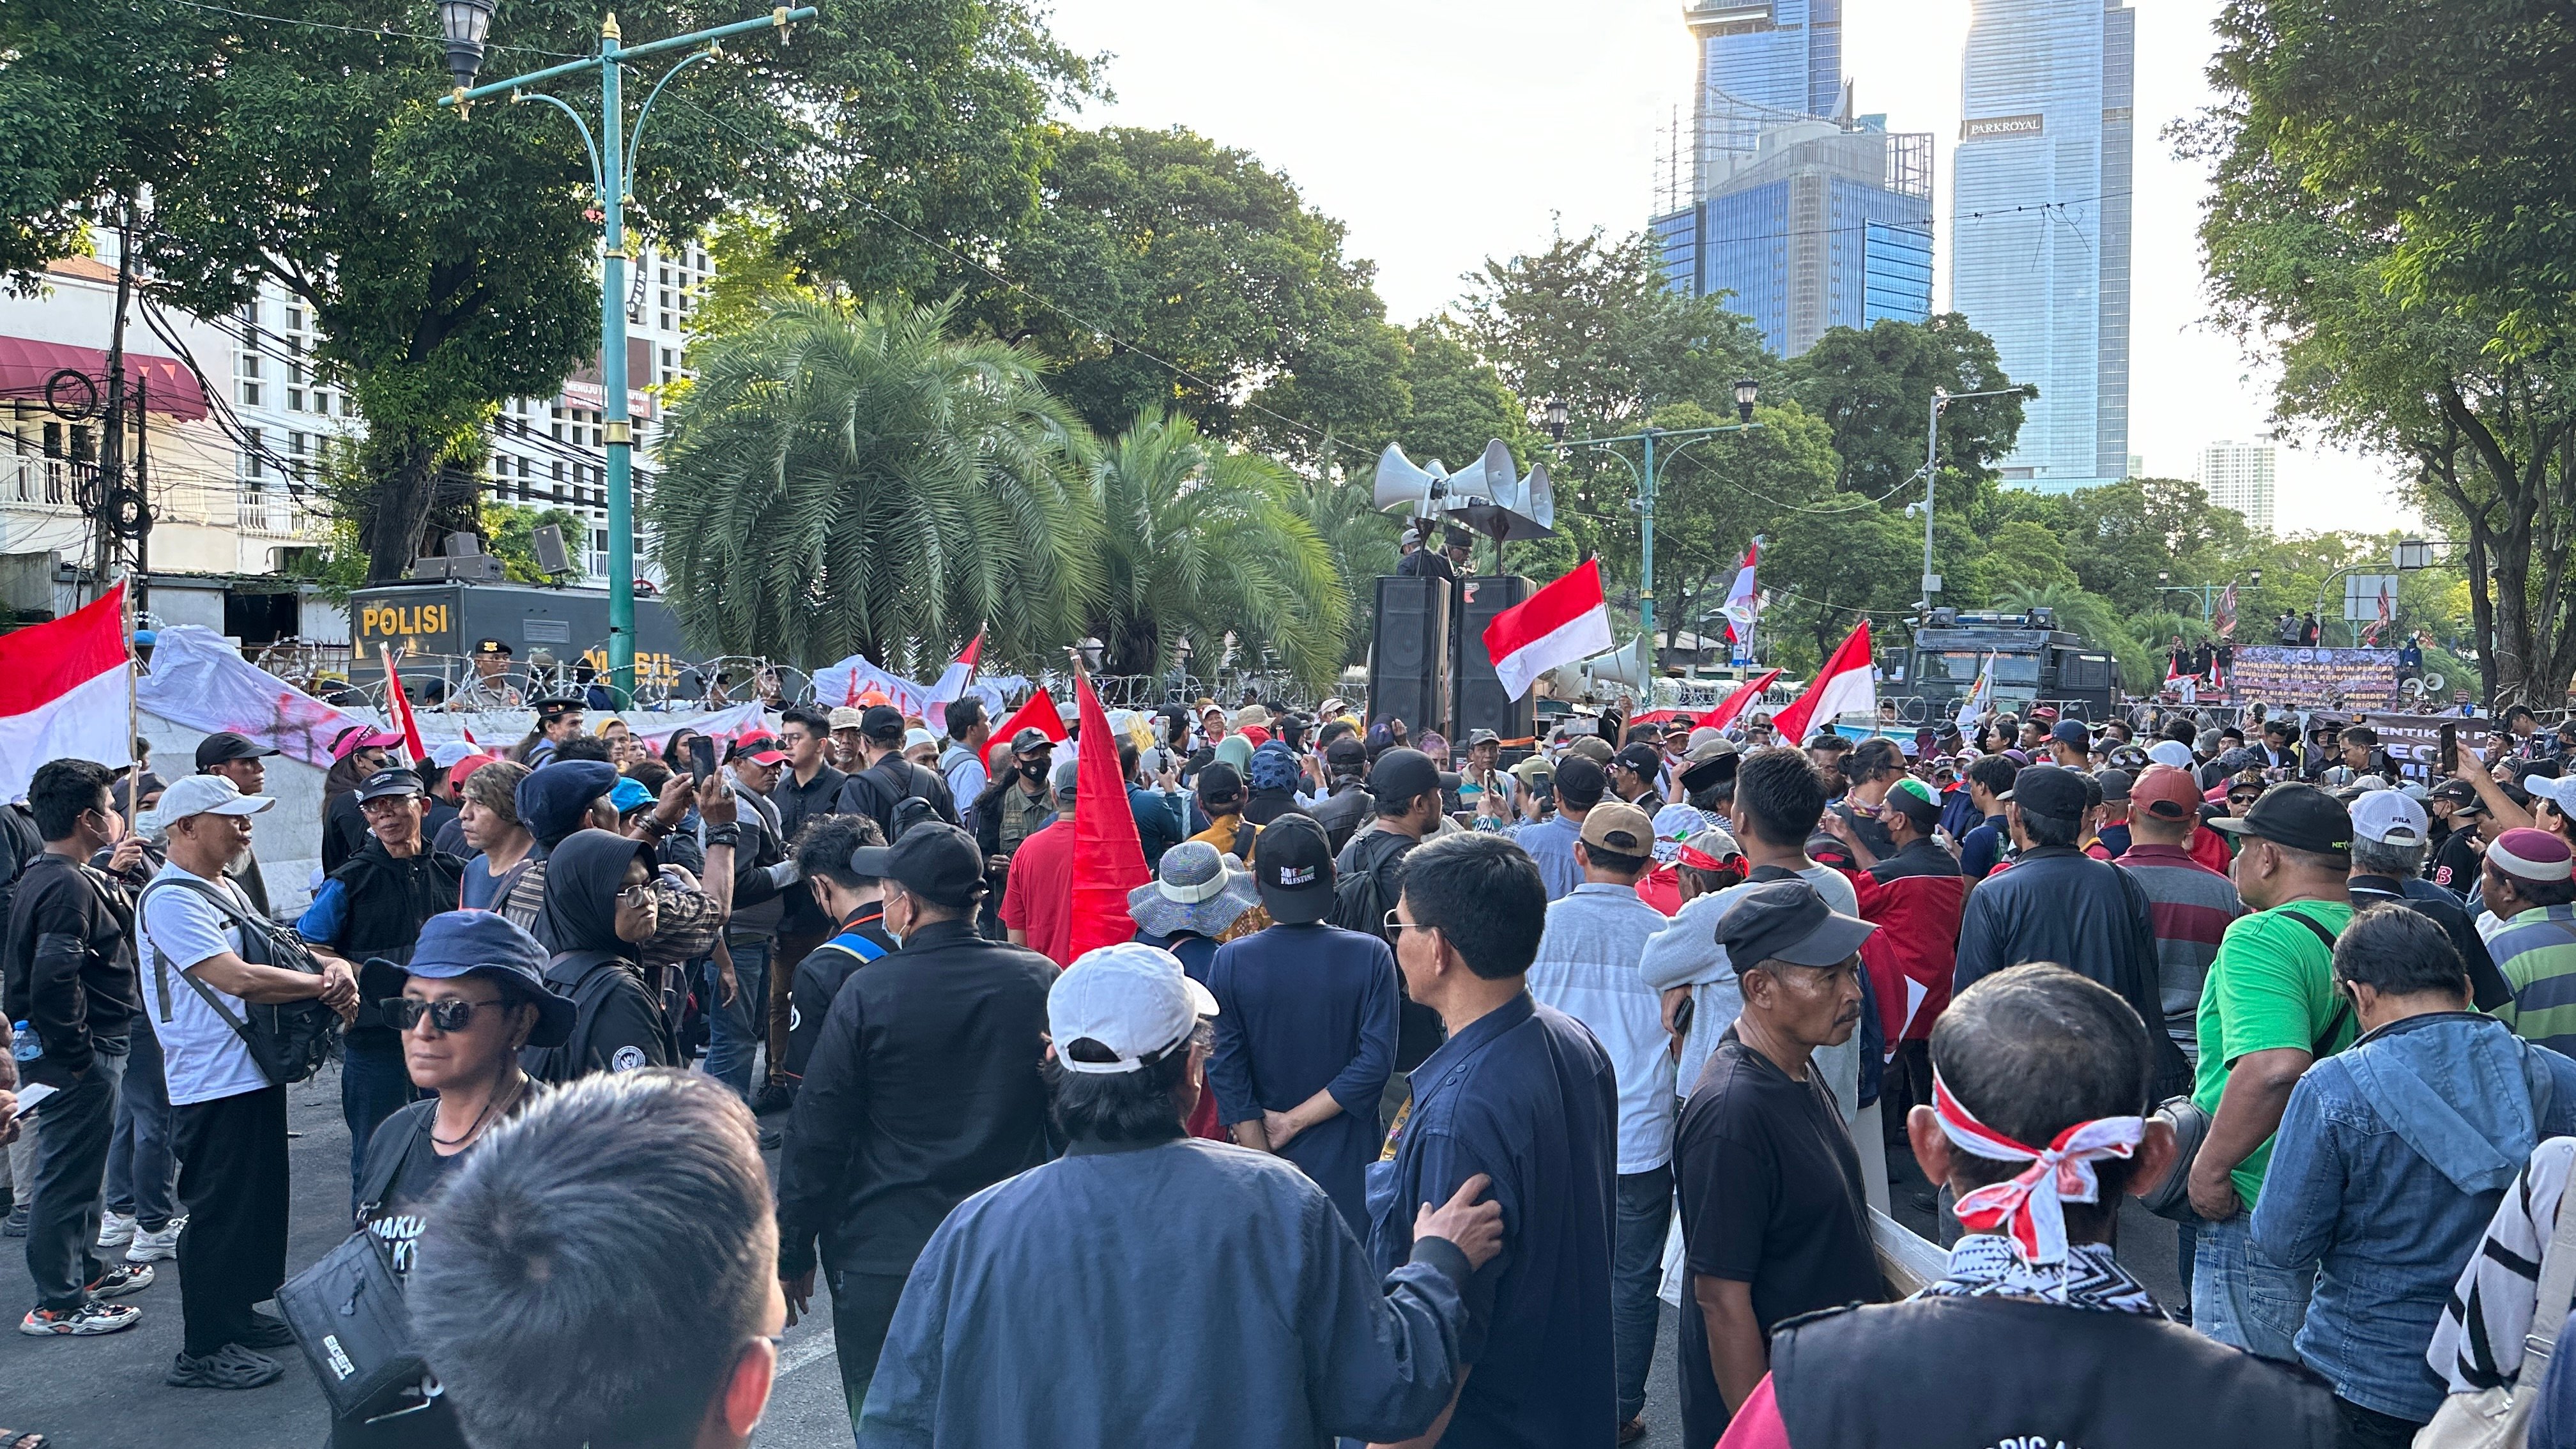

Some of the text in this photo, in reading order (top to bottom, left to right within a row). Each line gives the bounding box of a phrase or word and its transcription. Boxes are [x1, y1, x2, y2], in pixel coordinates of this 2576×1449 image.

[1971, 120, 2041, 134] PARKROYAL
[567, 383, 598, 395] MENUJU
[363, 604, 447, 636] POLISI
[583, 650, 679, 677] MBIL
[2235, 661, 2289, 670] MAHASISWA,
[1280, 866, 1298, 878] SAVE
[1281, 873, 1315, 885] PALESTINE
[2435, 866, 2453, 885] B
[324, 1335, 355, 1376] EIGER
